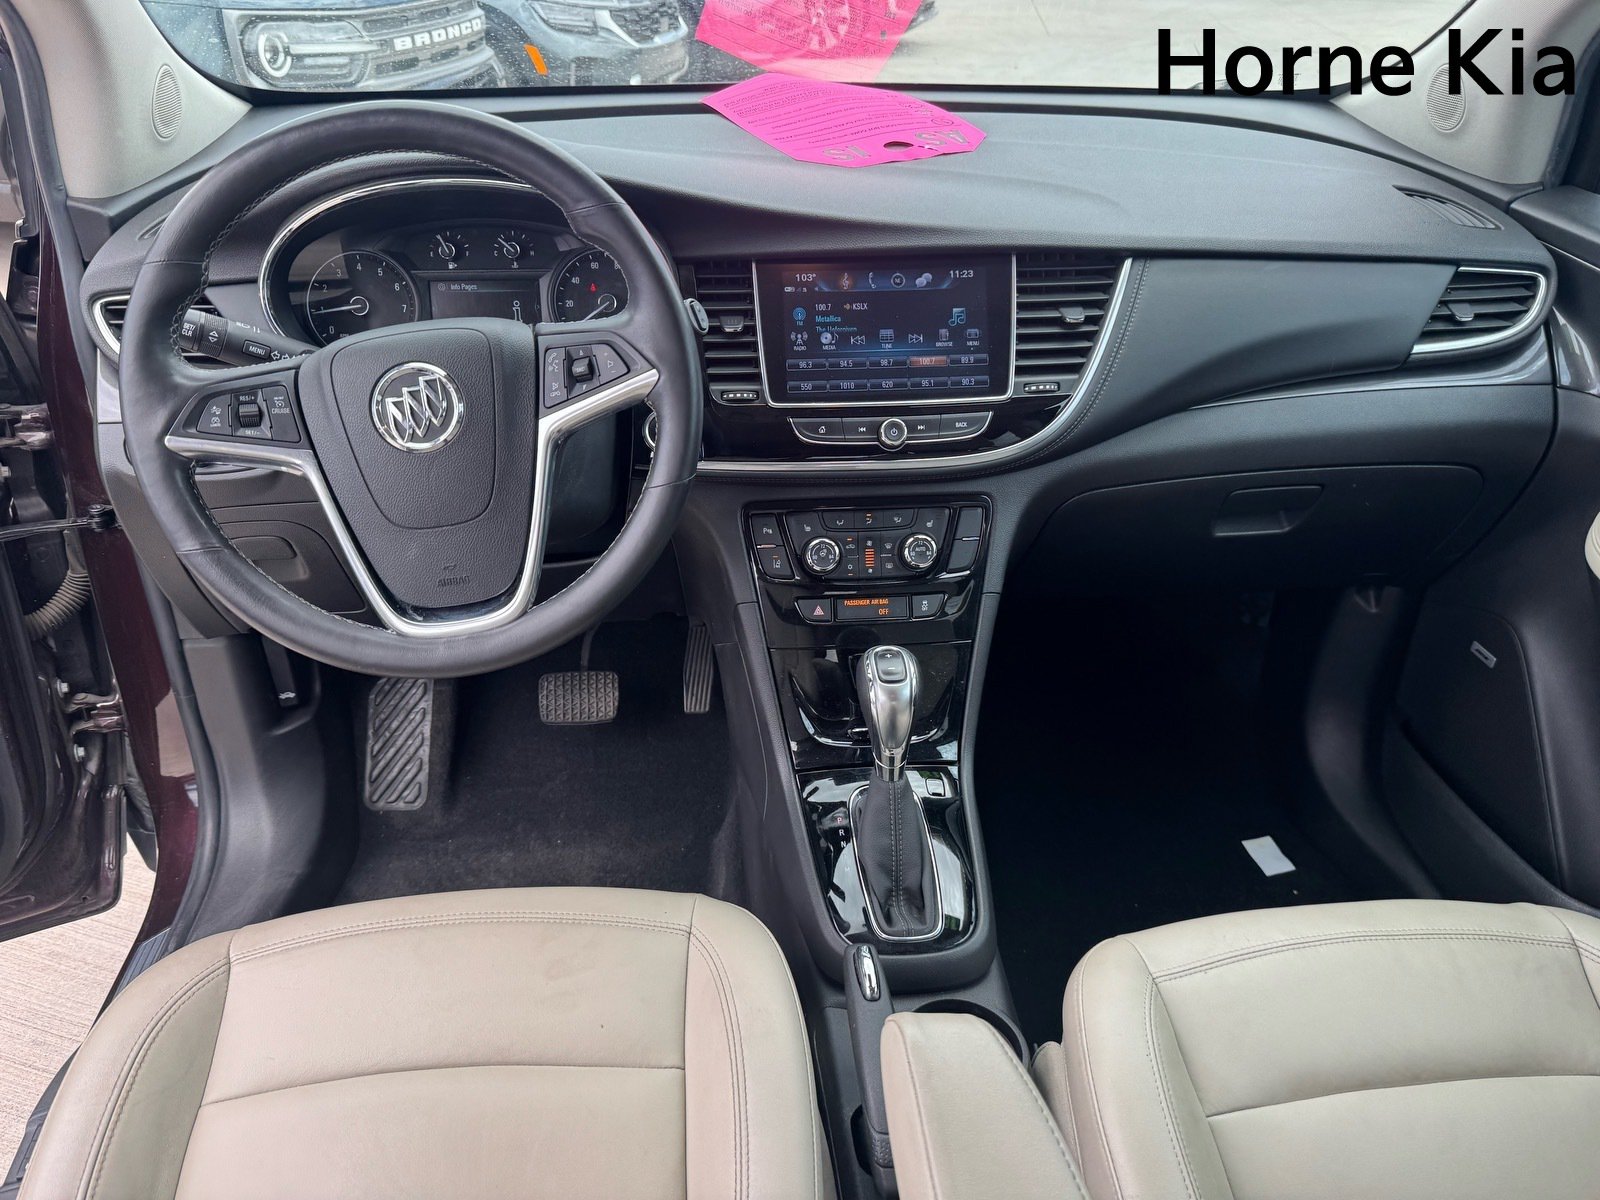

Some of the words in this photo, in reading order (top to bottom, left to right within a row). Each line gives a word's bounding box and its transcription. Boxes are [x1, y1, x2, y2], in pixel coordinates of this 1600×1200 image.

[394, 18, 481, 51] BRONCO
[356, 262, 362, 270] 4
[336, 269, 342, 277] 3
[378, 268, 382, 276] 5
[394, 282, 400, 290] 6
[462, 284, 478, 292] Pages
[402, 304, 406, 312] 7
[182, 329, 192, 337] CLR
[329, 326, 334, 334] 0
[249, 345, 266, 356] MENU
